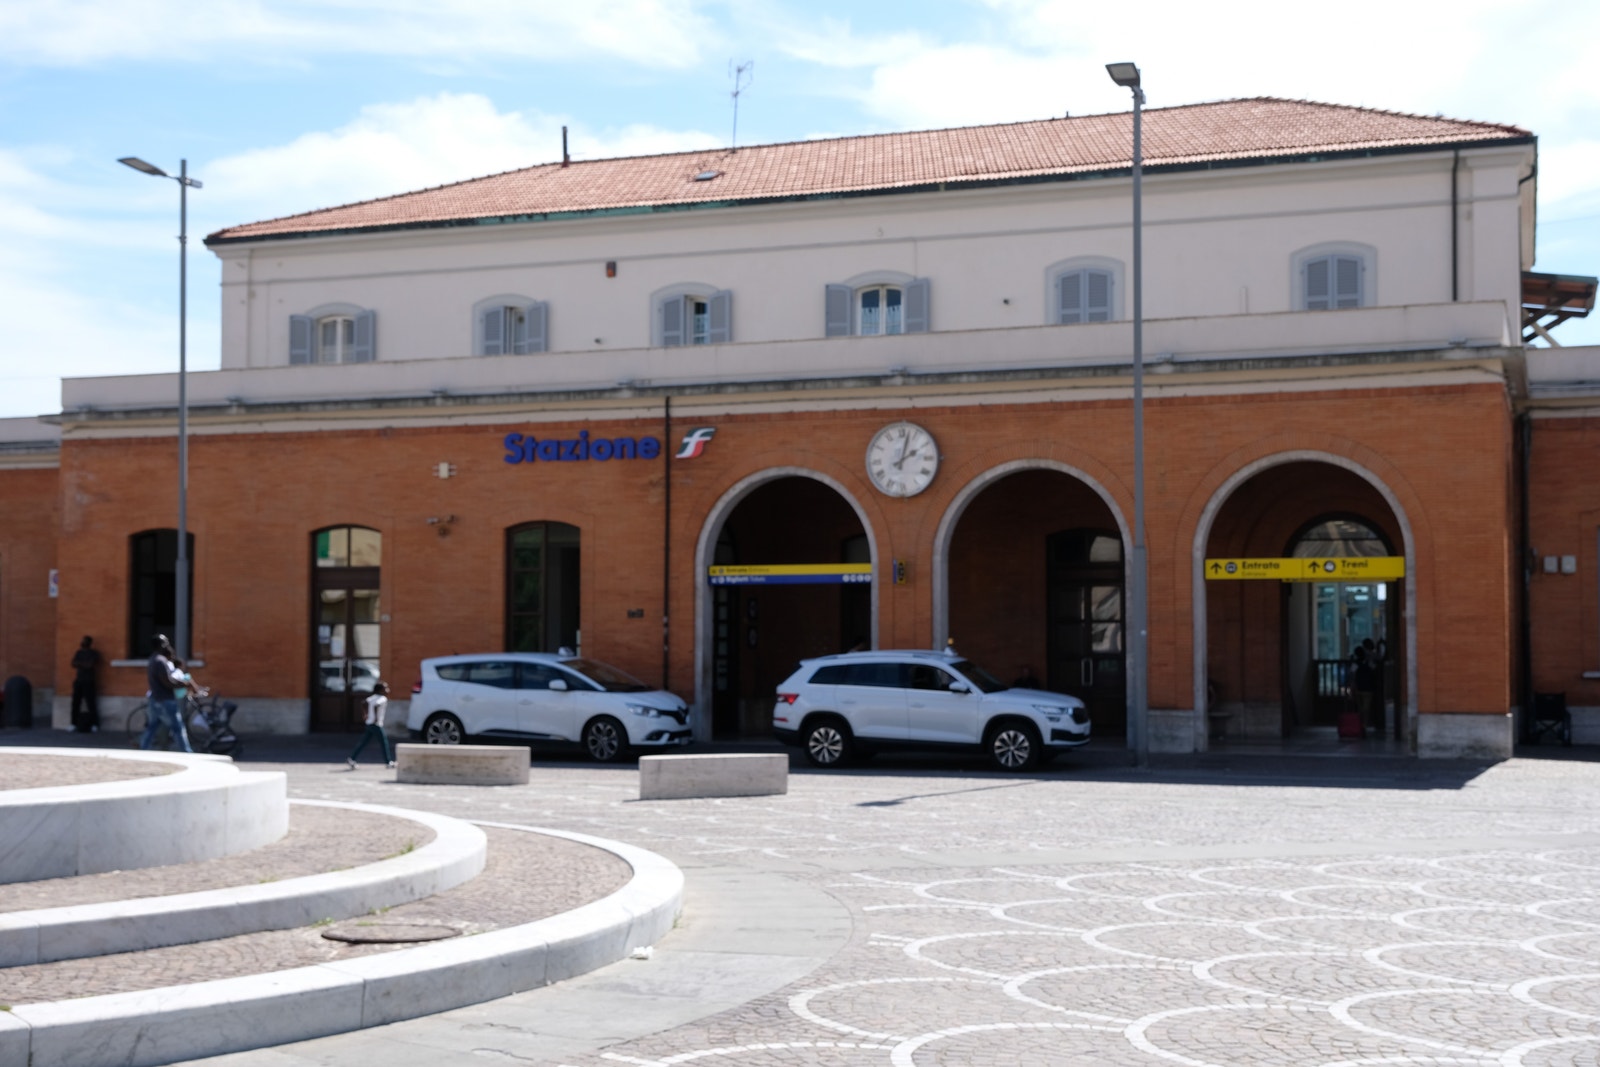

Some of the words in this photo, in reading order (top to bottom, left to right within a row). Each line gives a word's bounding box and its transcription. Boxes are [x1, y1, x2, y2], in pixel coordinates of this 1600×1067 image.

[504, 430, 661, 464] Stazione
[1242, 561, 1280, 570] Entrata
[1341, 560, 1369, 569] Treni
